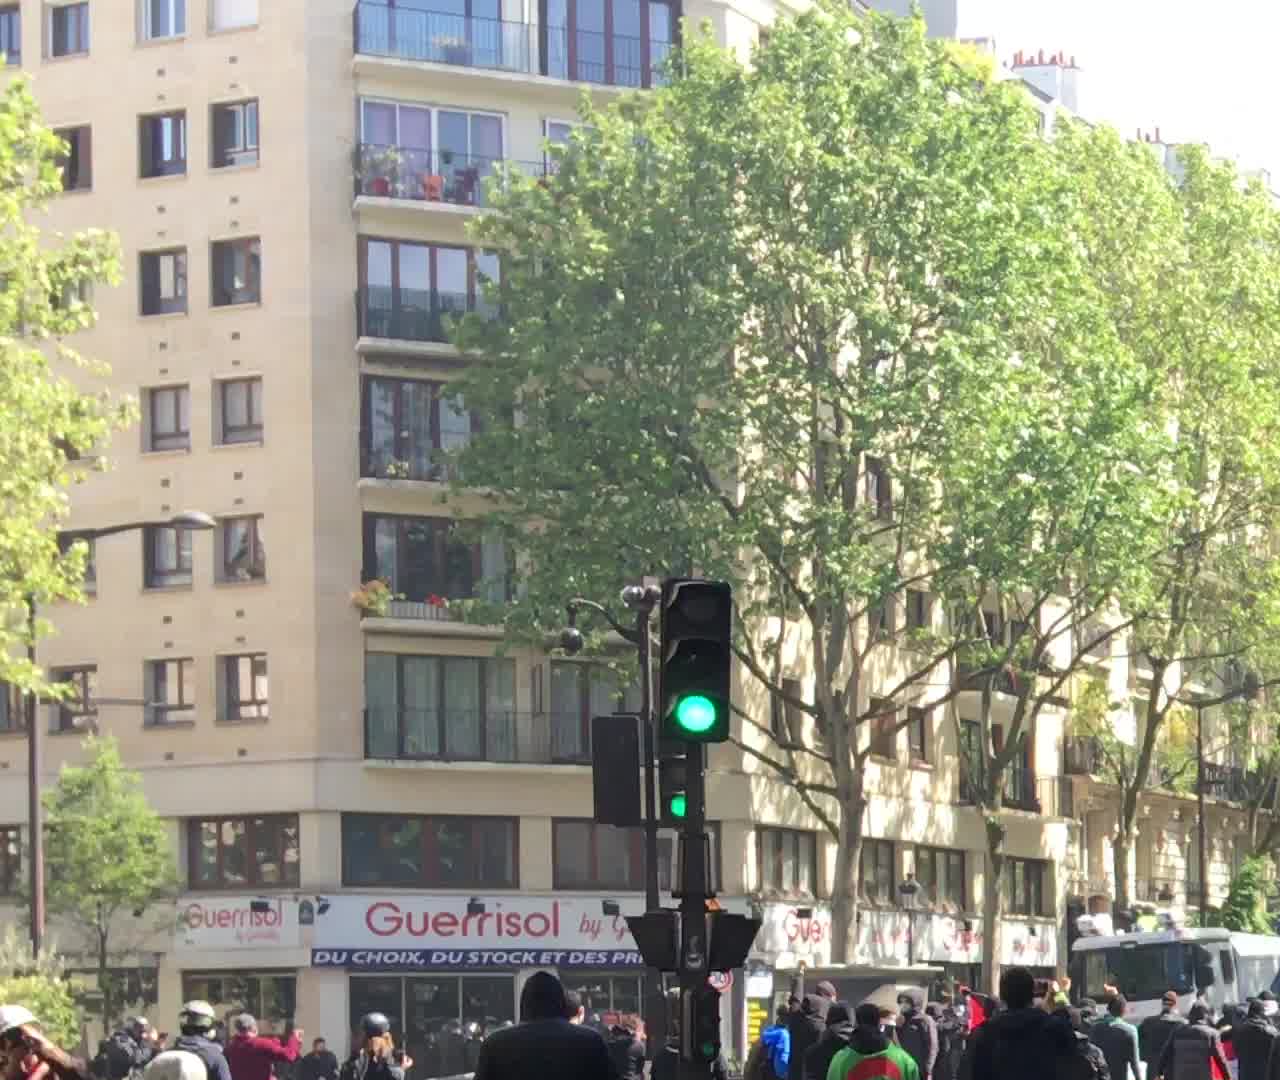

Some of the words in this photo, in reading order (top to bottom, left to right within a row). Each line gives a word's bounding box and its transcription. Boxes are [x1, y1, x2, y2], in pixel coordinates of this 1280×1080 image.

[184, 902, 283, 929] Guerrisol
[365, 900, 560, 938] Guerrisol
[313, 951, 348, 964] DU
[351, 951, 425, 967] CHOIX,
[431, 951, 464, 964] DU
[466, 951, 537, 965] STOCK
[540, 951, 568, 964] ET
[568, 951, 608, 964] DES
